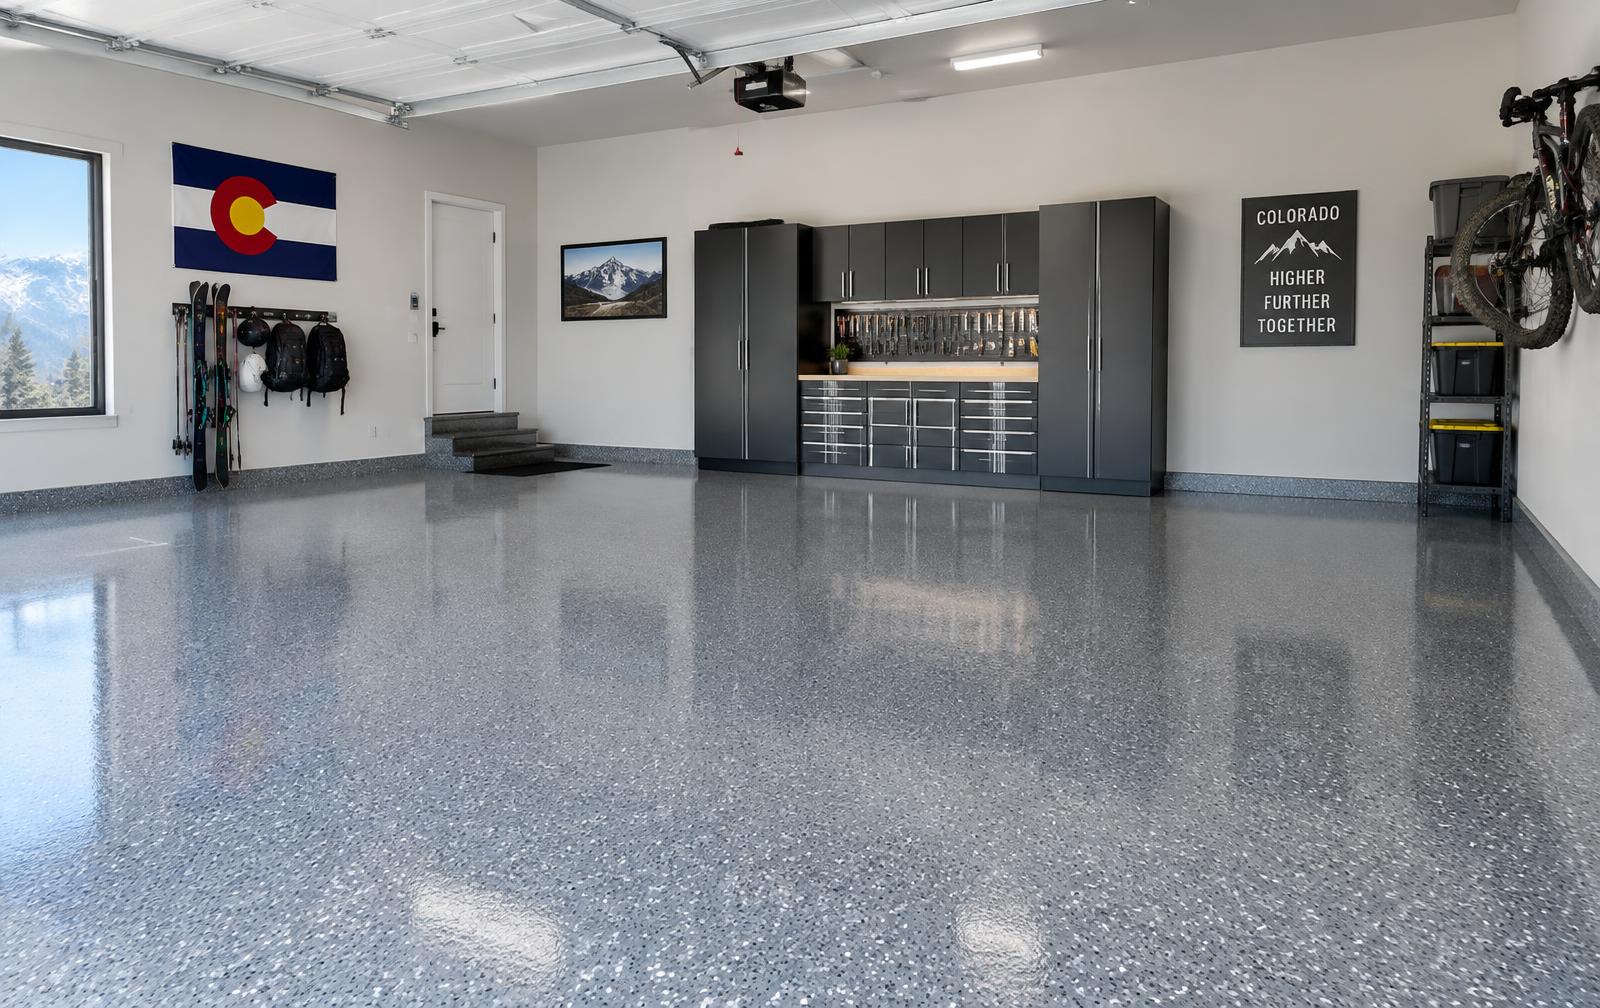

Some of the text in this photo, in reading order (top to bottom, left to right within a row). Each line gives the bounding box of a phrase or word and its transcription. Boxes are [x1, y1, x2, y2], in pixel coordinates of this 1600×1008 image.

[1257, 205, 1340, 225] COLORADO
[1270, 269, 1325, 286] HIGHER
[1264, 293, 1330, 310] FURTHER
[1257, 317, 1336, 333] TOGETHER
